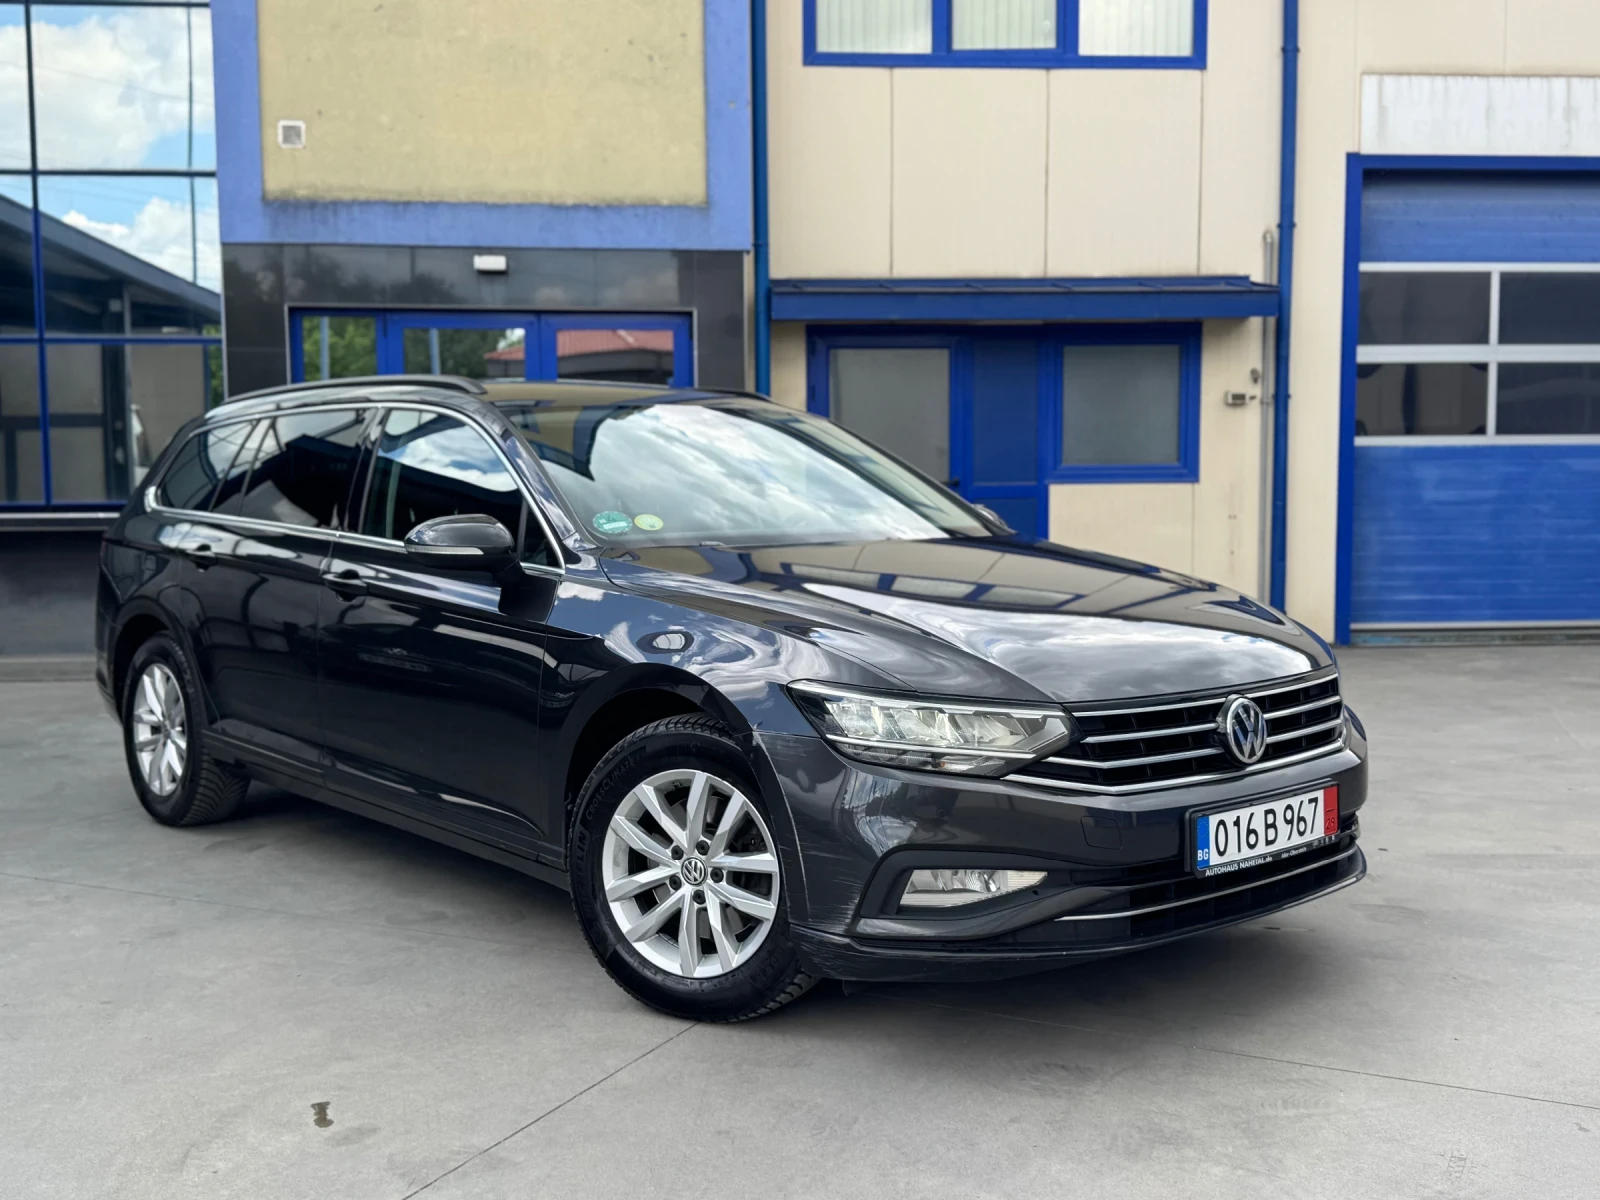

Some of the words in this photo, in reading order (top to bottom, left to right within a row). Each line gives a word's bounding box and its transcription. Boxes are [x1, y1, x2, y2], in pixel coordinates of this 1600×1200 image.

[1230, 700, 1265, 761] VW
[1197, 849, 1209, 860] BG
[1205, 863, 1239, 877] AUTOHAUS
[1240, 856, 1273, 869] NAHETAL.de
